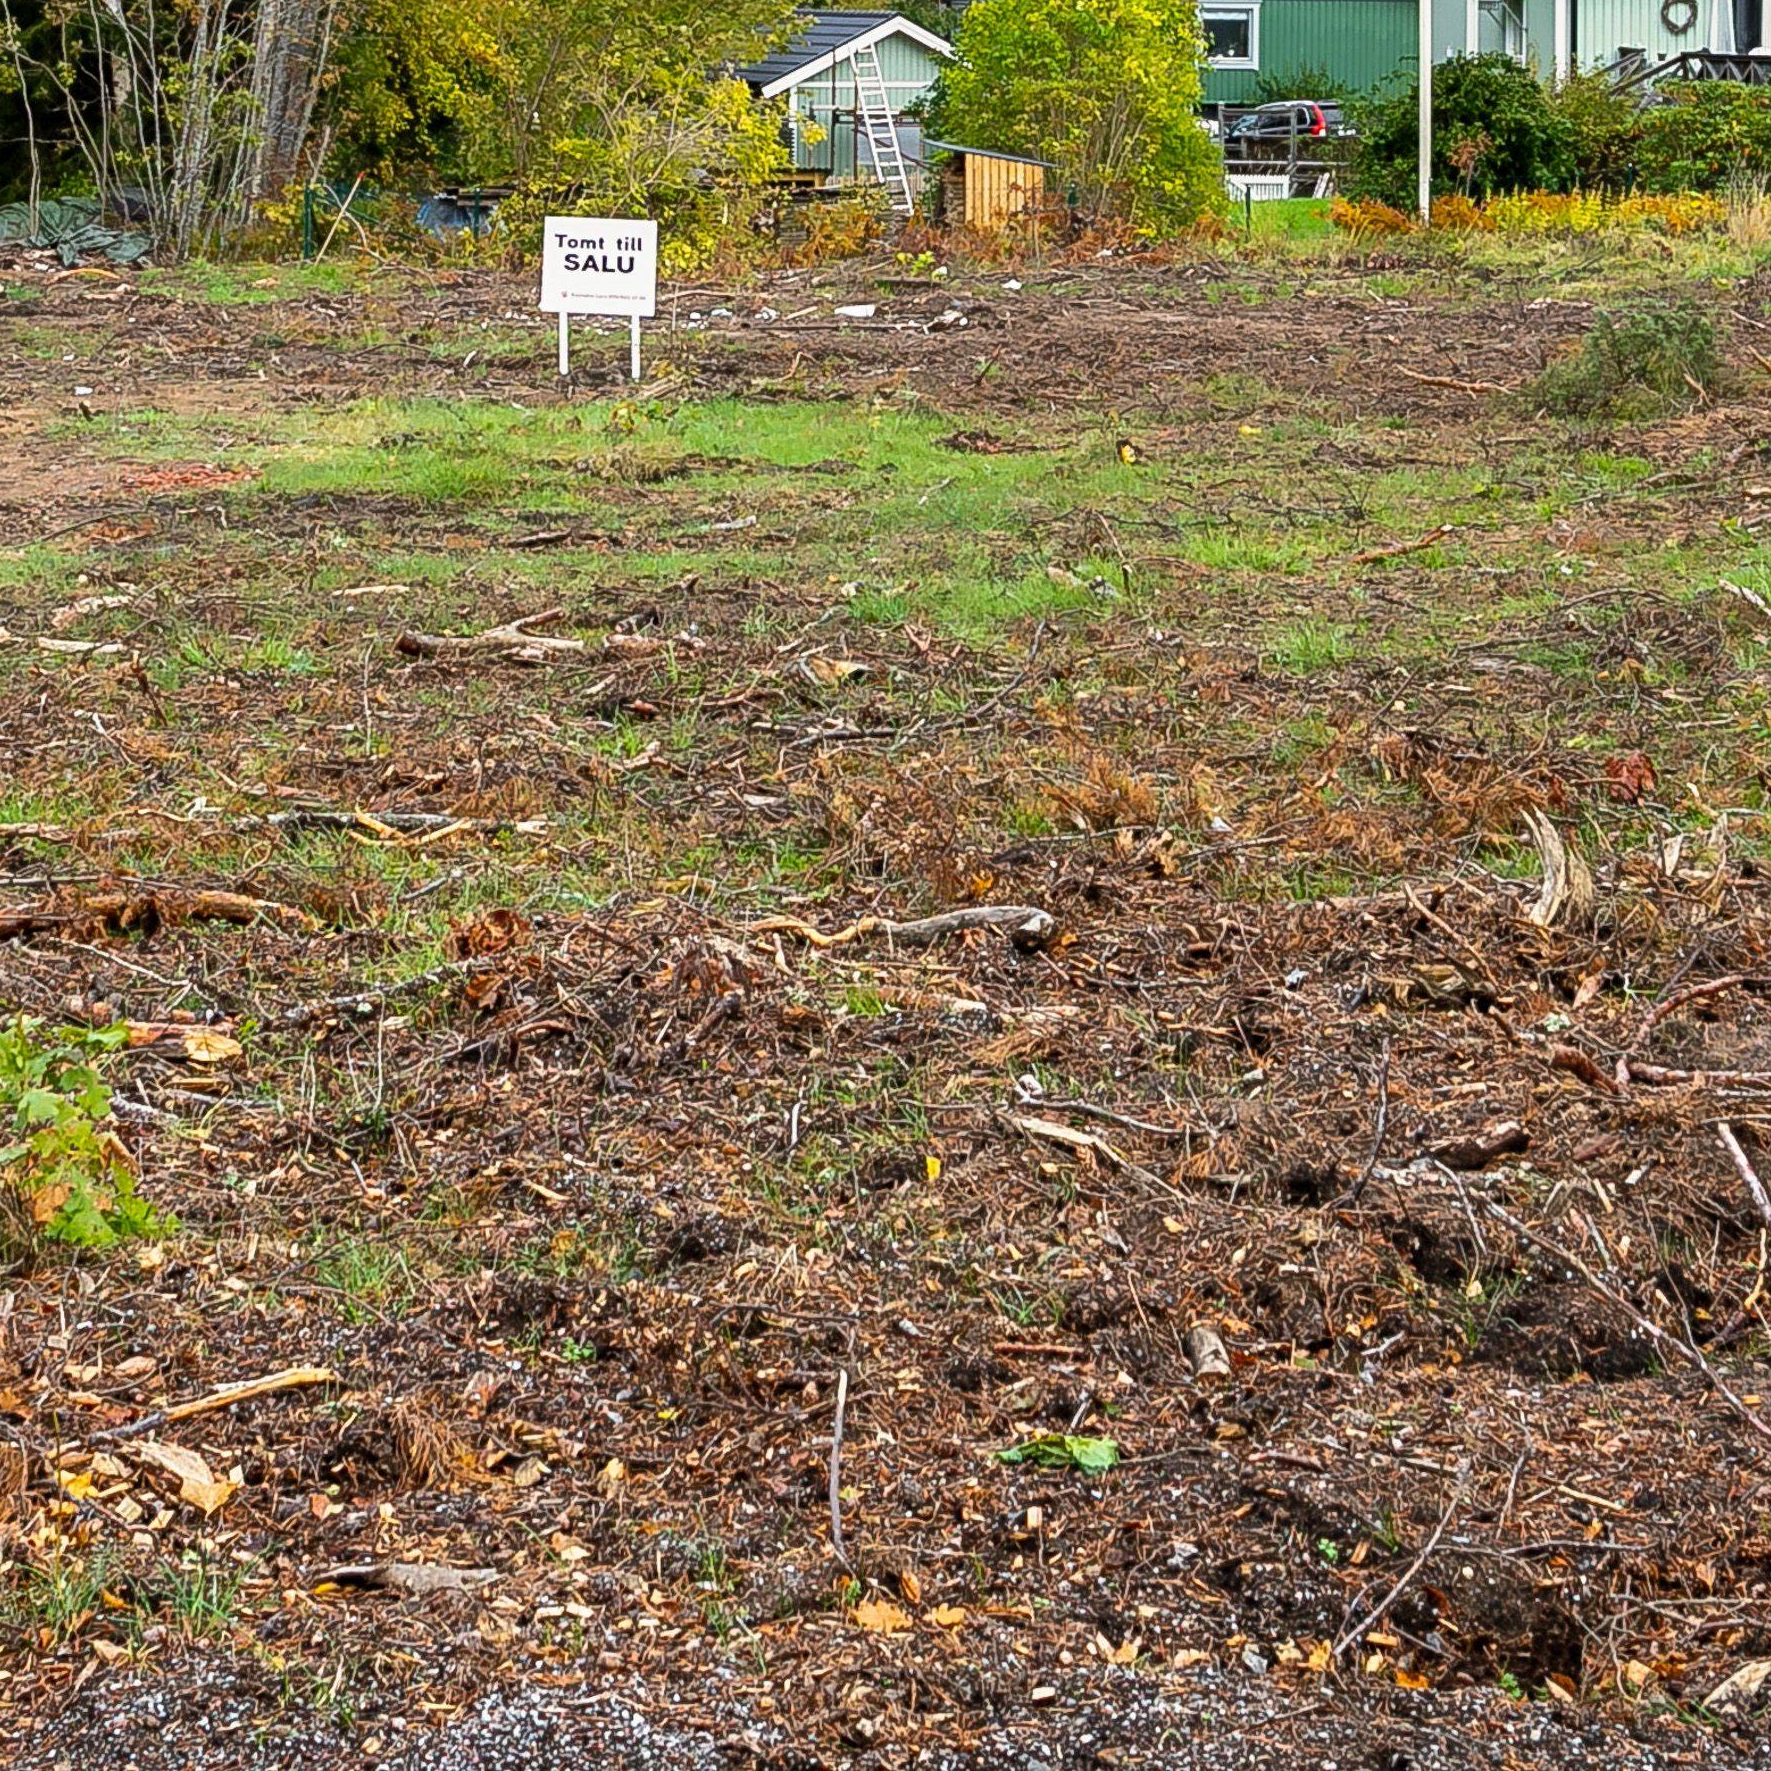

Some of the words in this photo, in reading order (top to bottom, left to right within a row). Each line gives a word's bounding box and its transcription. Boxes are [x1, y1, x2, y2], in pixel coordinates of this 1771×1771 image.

[554, 233, 605, 250] Tomt
[616, 236, 642, 252] till
[563, 253, 635, 274] SALU
